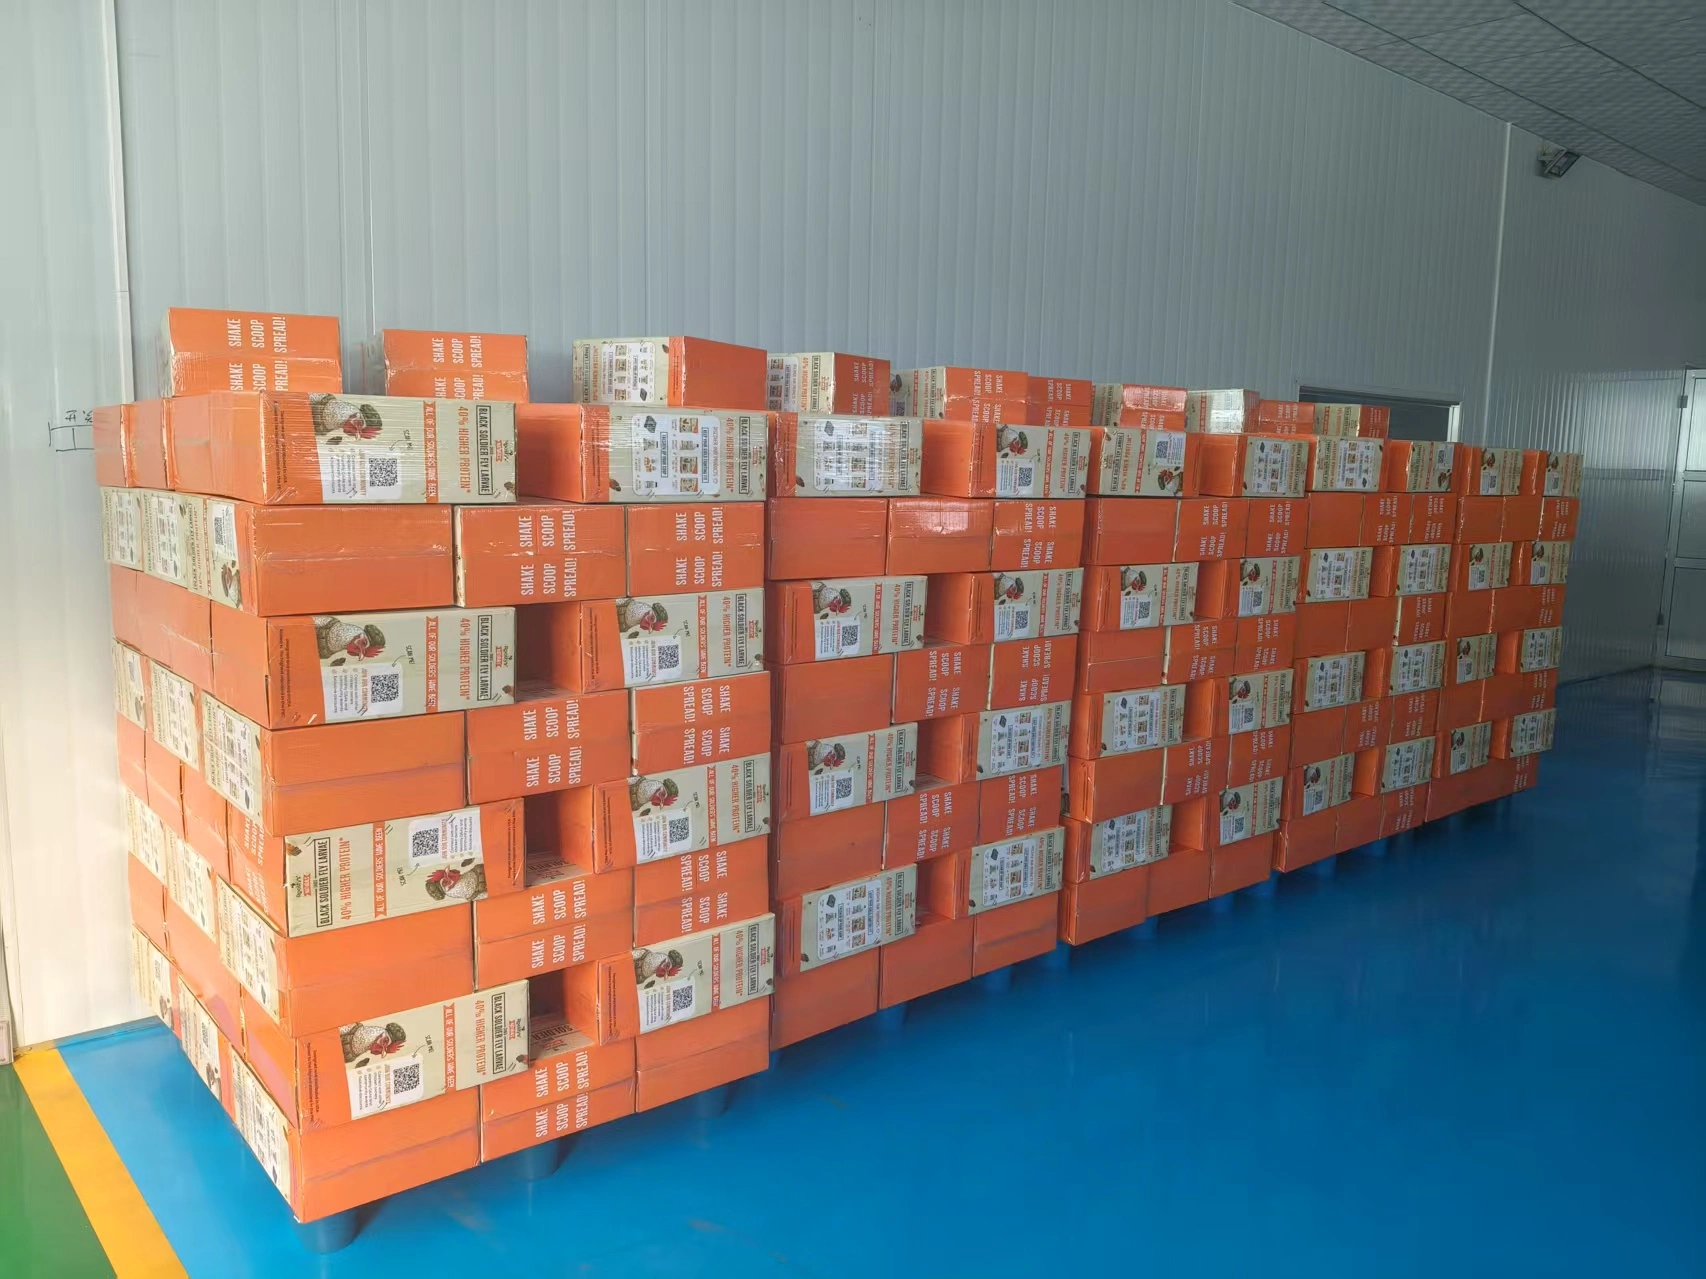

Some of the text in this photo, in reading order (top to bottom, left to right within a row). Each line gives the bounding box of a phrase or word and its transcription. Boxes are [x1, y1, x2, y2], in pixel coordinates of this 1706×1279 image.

[227, 318, 241, 347] SHAKE
[250, 320, 264, 348] SCOOP
[273, 317, 287, 352] SPREAD!
[432, 338, 444, 362] SHAKE
[452, 338, 463, 363] SCOOP
[470, 335, 482, 368] SPREAD!
[229, 363, 243, 391] SHAKE
[275, 360, 288, 391] PREAD!
[435, 377, 446, 400] HAKE
[473, 374, 484, 400] PREAD!
[458, 407, 468, 425] 40%
[726, 417, 734, 435] 40%
[459, 428, 469, 454] HIGHER
[479, 408, 490, 492] BLACK SOLDIER FLY LARVAE
[726, 436, 734, 460] HIGHER
[519, 516, 532, 547] SHAKE
[541, 515, 554, 547] SCOOP
[562, 510, 576, 550] SPREAD!
[676, 512, 687, 541] SHAKE
[694, 511, 705, 540] SCOOP
[712, 507, 724, 544] SPREAD!
[1025, 503, 1033, 534] SPREAD!
[1021, 538, 1031, 568] SPREAD!
[1033, 541, 1042, 564] SCOOP
[1045, 541, 1054, 564] SHAKE
[521, 564, 534, 596] SHAKE
[543, 563, 556, 594] SCOOP
[564, 558, 577, 597] SPREAD!
[676, 557, 687, 586] SHAKE
[694, 556, 706, 585] SCOOP
[712, 551, 723, 587] SPREAD!
[723, 597, 731, 612] 40%
[428, 621, 436, 629] ALL
[460, 618, 471, 636] 40%
[723, 614, 731, 636] HIGHER
[460, 639, 470, 664] HIGHER
[480, 618, 489, 698] BLACK SOLDIER FLY LARVAE
[929, 650, 937, 682] SPREAD!
[941, 653, 950, 676] SCOOP
[953, 651, 962, 675] SHAKE
[428, 694, 436, 707] BEEN
[683, 686, 696, 723] SPREAD!
[702, 688, 712, 716] SCOOP
[719, 685, 731, 713] SHAKE
[925, 687, 936, 717] SPREAD!
[938, 688, 948, 712] SCOOP
[951, 686, 960, 709] SHAKE
[523, 709, 536, 740] SHAKE
[546, 707, 559, 738] SCOOP
[567, 699, 579, 739] SPREAD!
[683, 728, 695, 764] SPREAD!
[702, 729, 712, 757] SCOOP
[719, 726, 730, 753] SHAKE
[526, 756, 540, 788] SHAKE
[548, 754, 561, 784] SCOOP
[569, 746, 582, 785] SPREAD!
[920, 792, 928, 824] SPREAD!
[931, 795, 940, 818] SCOOP
[943, 792, 952, 815] SHAKE
[375, 828, 383, 840] BEEN
[916, 829, 927, 860] SPREAD!
[929, 829, 939, 852] SCOOP
[941, 827, 951, 849] SHAKE
[375, 843, 383, 855] HAVE
[376, 858, 384, 880] SOLDIERS
[681, 854, 692, 892] SPREAD!
[699, 854, 710, 882] SCOOP
[716, 850, 728, 879] SHAKE
[317, 840, 329, 924] BLACK SOLDIER FLY LARVAE
[340, 873, 351, 900] HIGHER
[376, 882, 384, 892] OUR
[399, 876, 407, 886] SCAN
[341, 902, 352, 920] 40%
[376, 903, 384, 912] ALL
[531, 893, 545, 925] SHAKE
[553, 890, 566, 920] SCOOP
[573, 879, 586, 918] SPREAD!
[700, 896, 710, 924] SCOOP
[717, 892, 728, 919] SHAKE
[682, 896, 692, 933] SPREAD!
[532, 938, 544, 969] SHAKE
[553, 934, 564, 963] SCOOP
[573, 924, 586, 962] SPREAD!
[475, 1000, 485, 1017] 40%
[424, 1035, 432, 1045] SCAN
[446, 1028, 454, 1037] OUR
[475, 1019, 485, 1043] HIGHER
[494, 996, 504, 1071] BLACK SOLDIER FLY LARVAE
[446, 1039, 454, 1061] SOLDIERS
[536, 1067, 549, 1098] SHAKE
[558, 1061, 570, 1092] SCOOP
[578, 1050, 590, 1089] SPREAD!
[536, 1108, 548, 1138] SHAKE
[556, 1103, 569, 1132] SCOOP
[576, 1092, 589, 1129] SPREAD!
